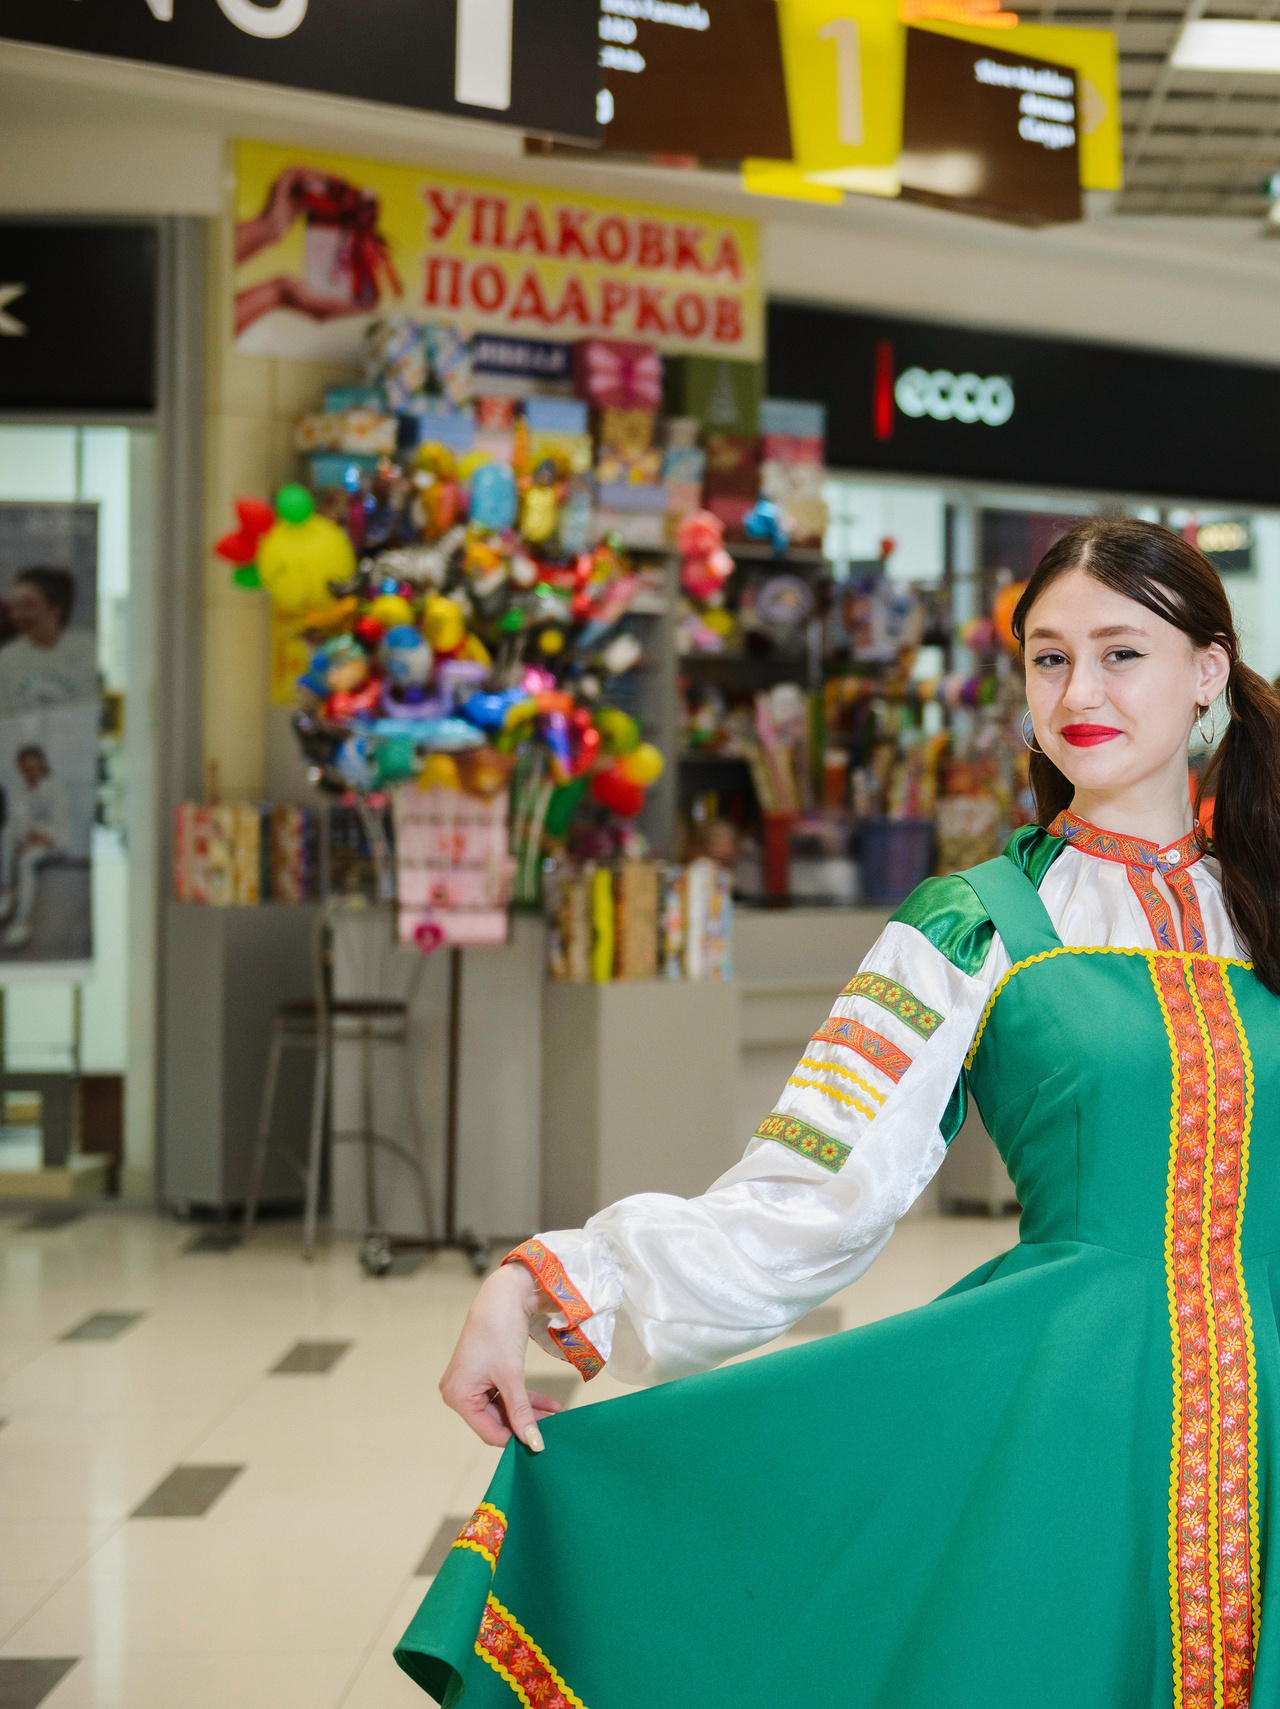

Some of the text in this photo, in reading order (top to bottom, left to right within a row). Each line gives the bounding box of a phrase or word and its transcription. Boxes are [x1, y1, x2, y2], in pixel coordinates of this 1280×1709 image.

[818, 17, 863, 147] 1
[424, 187, 742, 281] УПАКОВКА
[424, 255, 743, 343] ПОДАРКОВ
[895, 366, 1015, 426] ecco
